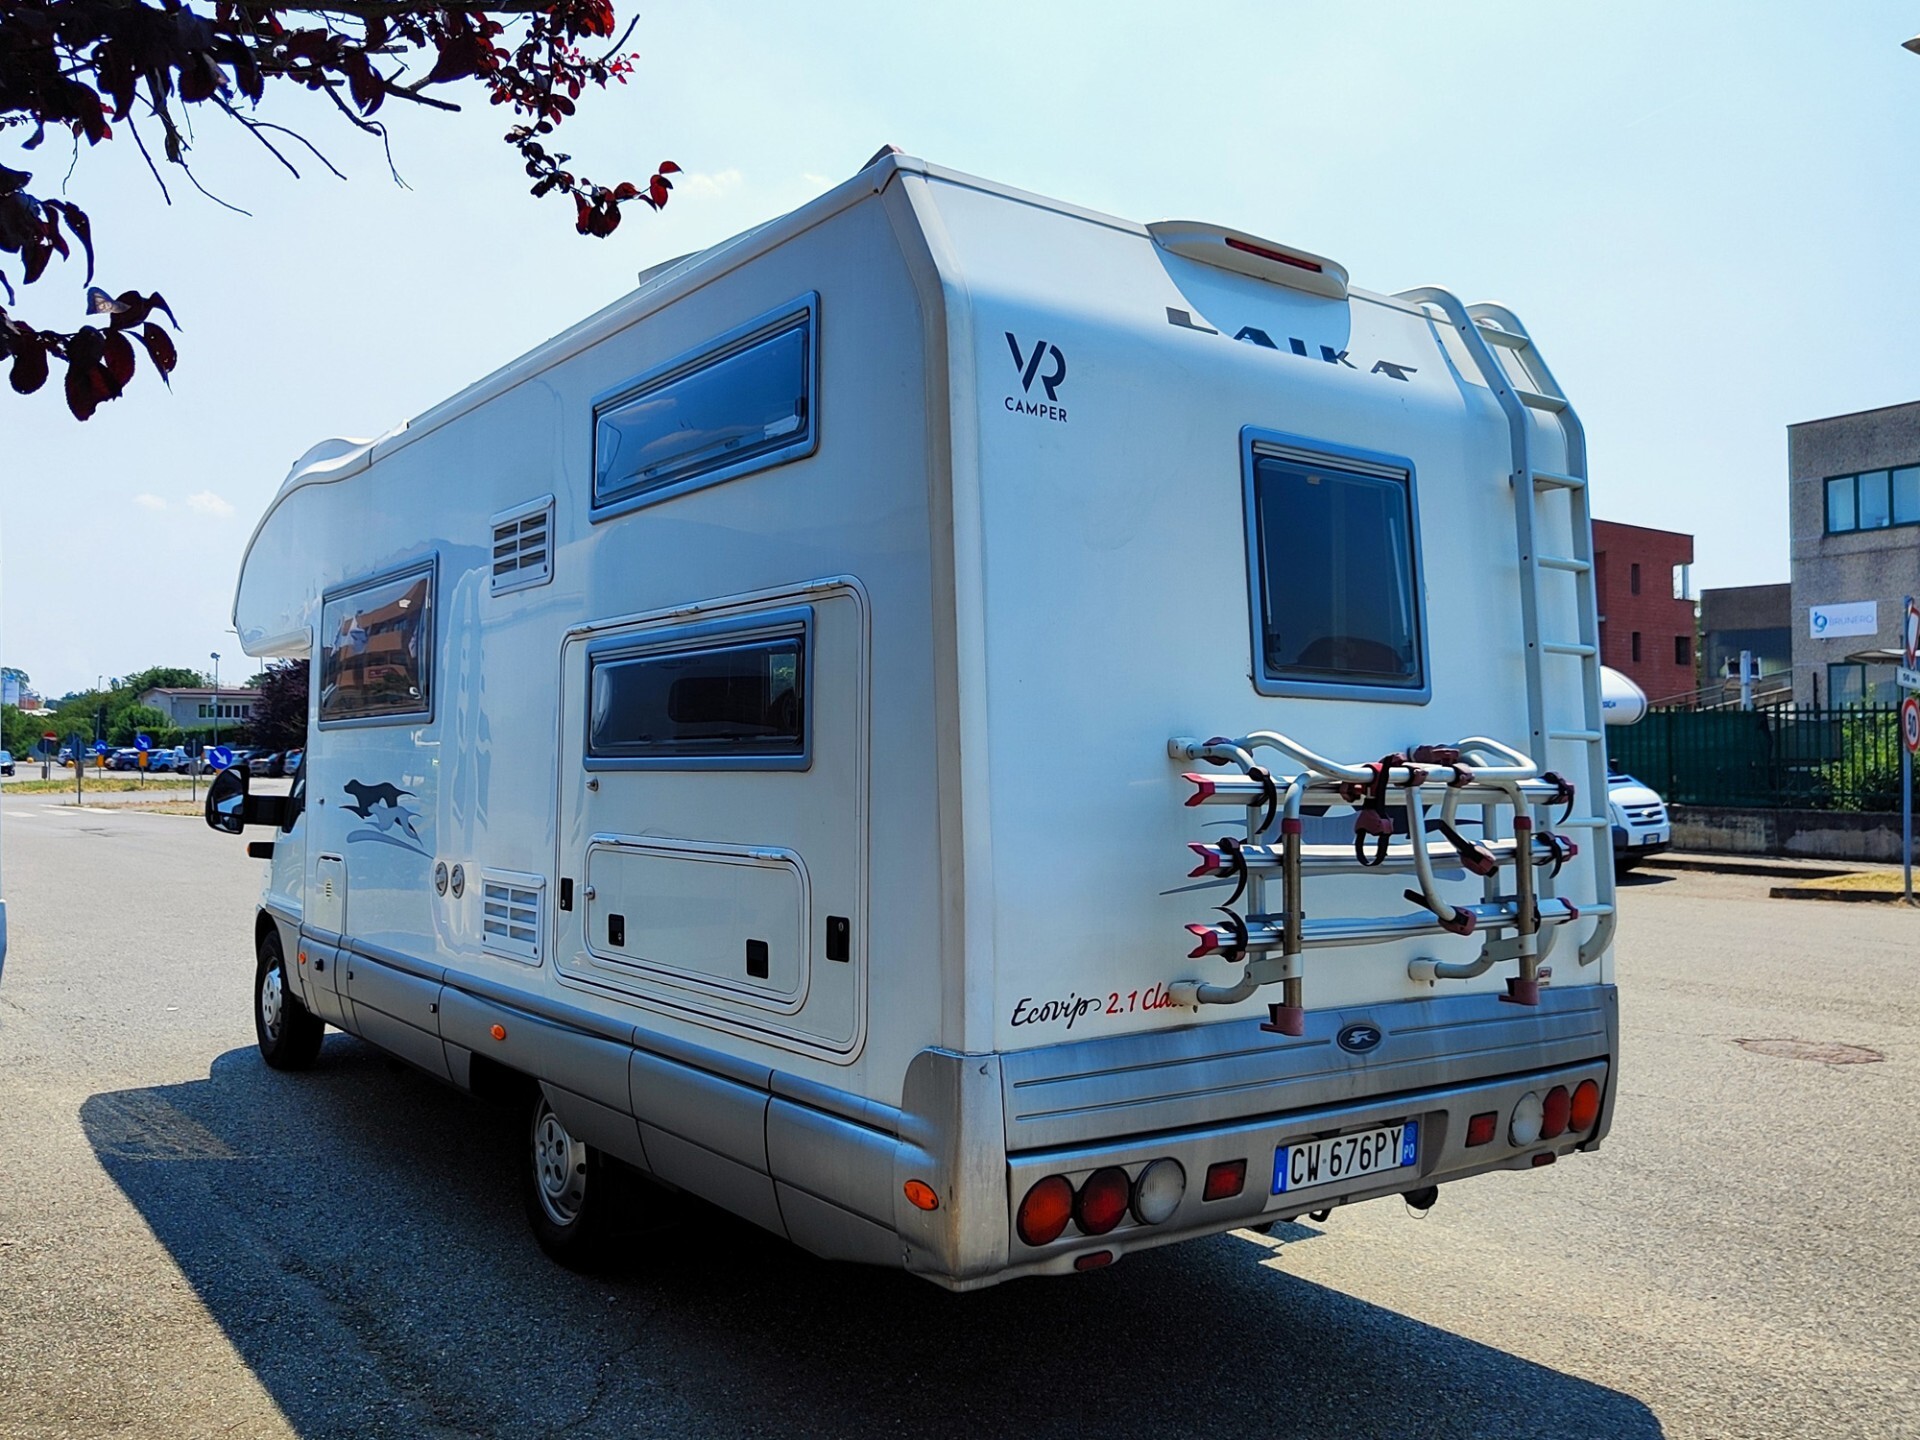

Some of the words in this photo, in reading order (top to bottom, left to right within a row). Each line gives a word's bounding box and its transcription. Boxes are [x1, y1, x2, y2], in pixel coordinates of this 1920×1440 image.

[1165, 306, 1418, 382] LAIKA
[1005, 331, 1066, 402] VR
[1005, 396, 1067, 423] CAMPER
[1908, 713, 1917, 738] 50
[1011, 993, 1101, 1029] Ecovip
[1106, 991, 1138, 1014] 2.1
